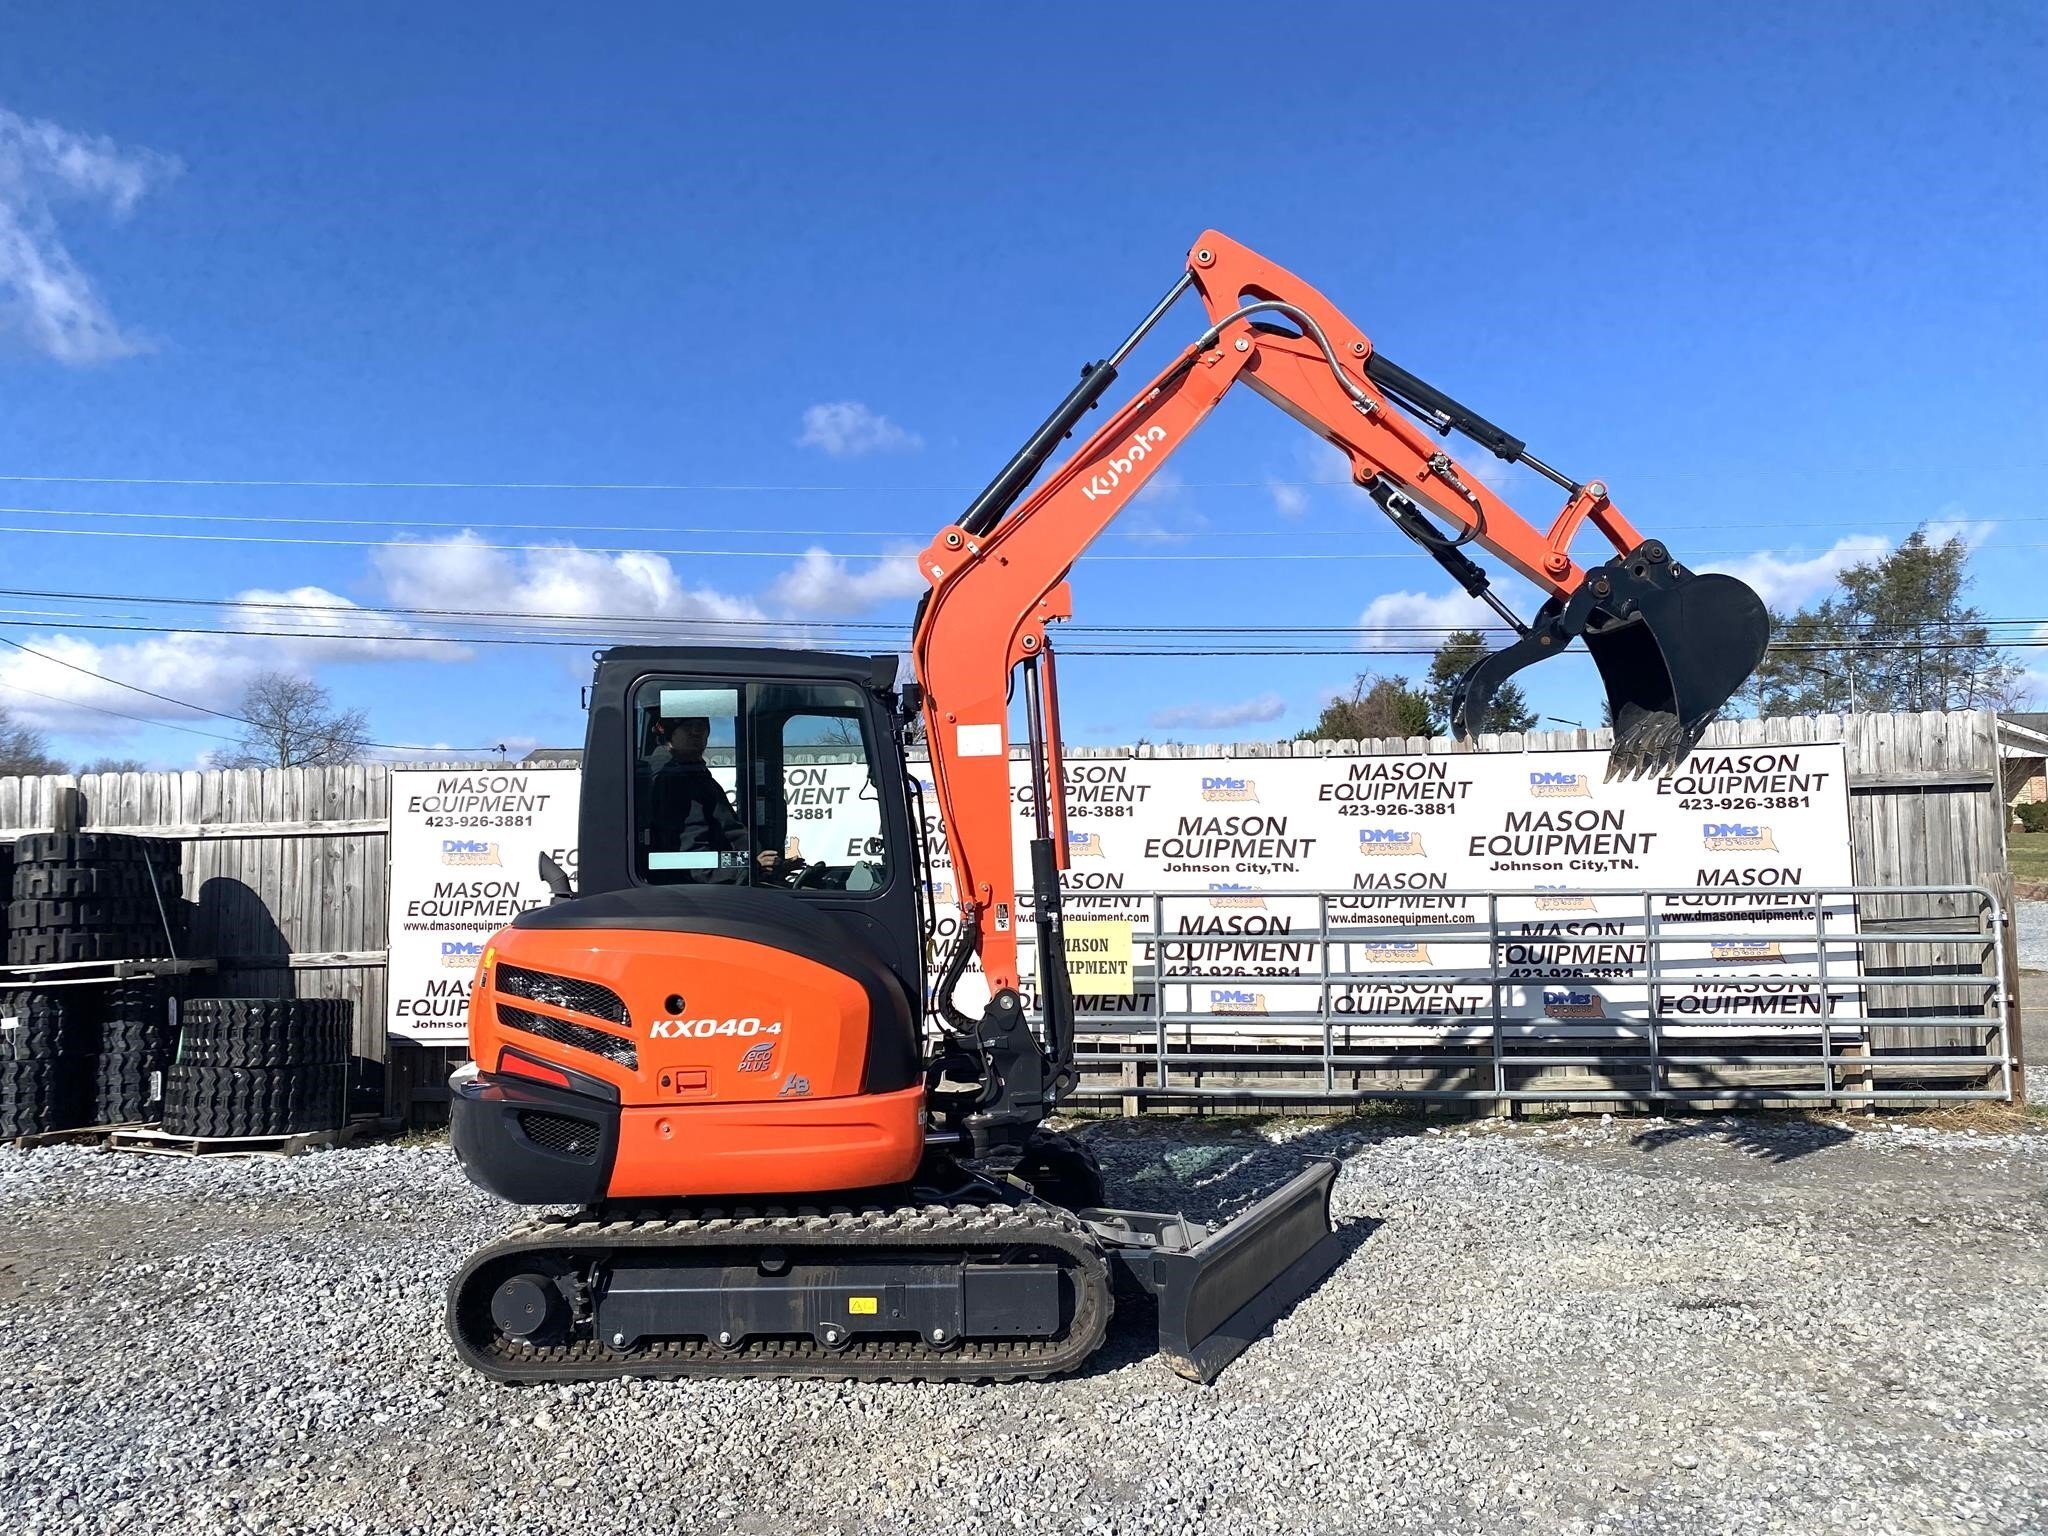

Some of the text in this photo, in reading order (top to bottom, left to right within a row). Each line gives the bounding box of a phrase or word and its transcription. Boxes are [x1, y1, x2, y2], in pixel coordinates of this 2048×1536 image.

[1081, 425, 1168, 501] Kubota
[1349, 762, 1447, 781] MASON
[1689, 754, 1799, 774] MASON
[437, 776, 528, 794] MASON
[1319, 781, 1473, 801] EQUIPMENT
[1656, 773, 1829, 795] EQUIPMENT
[408, 795, 550, 813] EQUIPMENT
[1338, 803, 1455, 816] 423-926-3881
[1679, 796, 1810, 810] 423-926-3881
[425, 815, 532, 827] 423-926-3881
[1178, 816, 1287, 836] MASON
[1505, 809, 1625, 832] MASON
[1144, 838, 1316, 858] EQUIPMENT
[1468, 833, 1657, 856] EQUIPMENT
[1163, 862, 1300, 875] Johnson City,TN.
[1489, 859, 1639, 872] Johnson City,TN.
[1353, 872, 1447, 889] MASON
[1696, 868, 1801, 886] MASON
[433, 881, 520, 898] MASON
[1665, 895, 1812, 906] EQUIPMEN
[1661, 909, 1833, 923] www.dmasonequipment.cm
[1178, 916, 1291, 936] MASON
[1521, 923, 1625, 935] MASON
[1166, 966, 1301, 977] 423-926-3881
[1509, 968, 1634, 977] 423-926-3881
[1317, 995, 1483, 1015] QUIPMENT
[1658, 995, 1843, 1015] EQUIPMENT
[650, 1018, 782, 1038] KX040-4
[737, 1061, 770, 1073] PLUS
